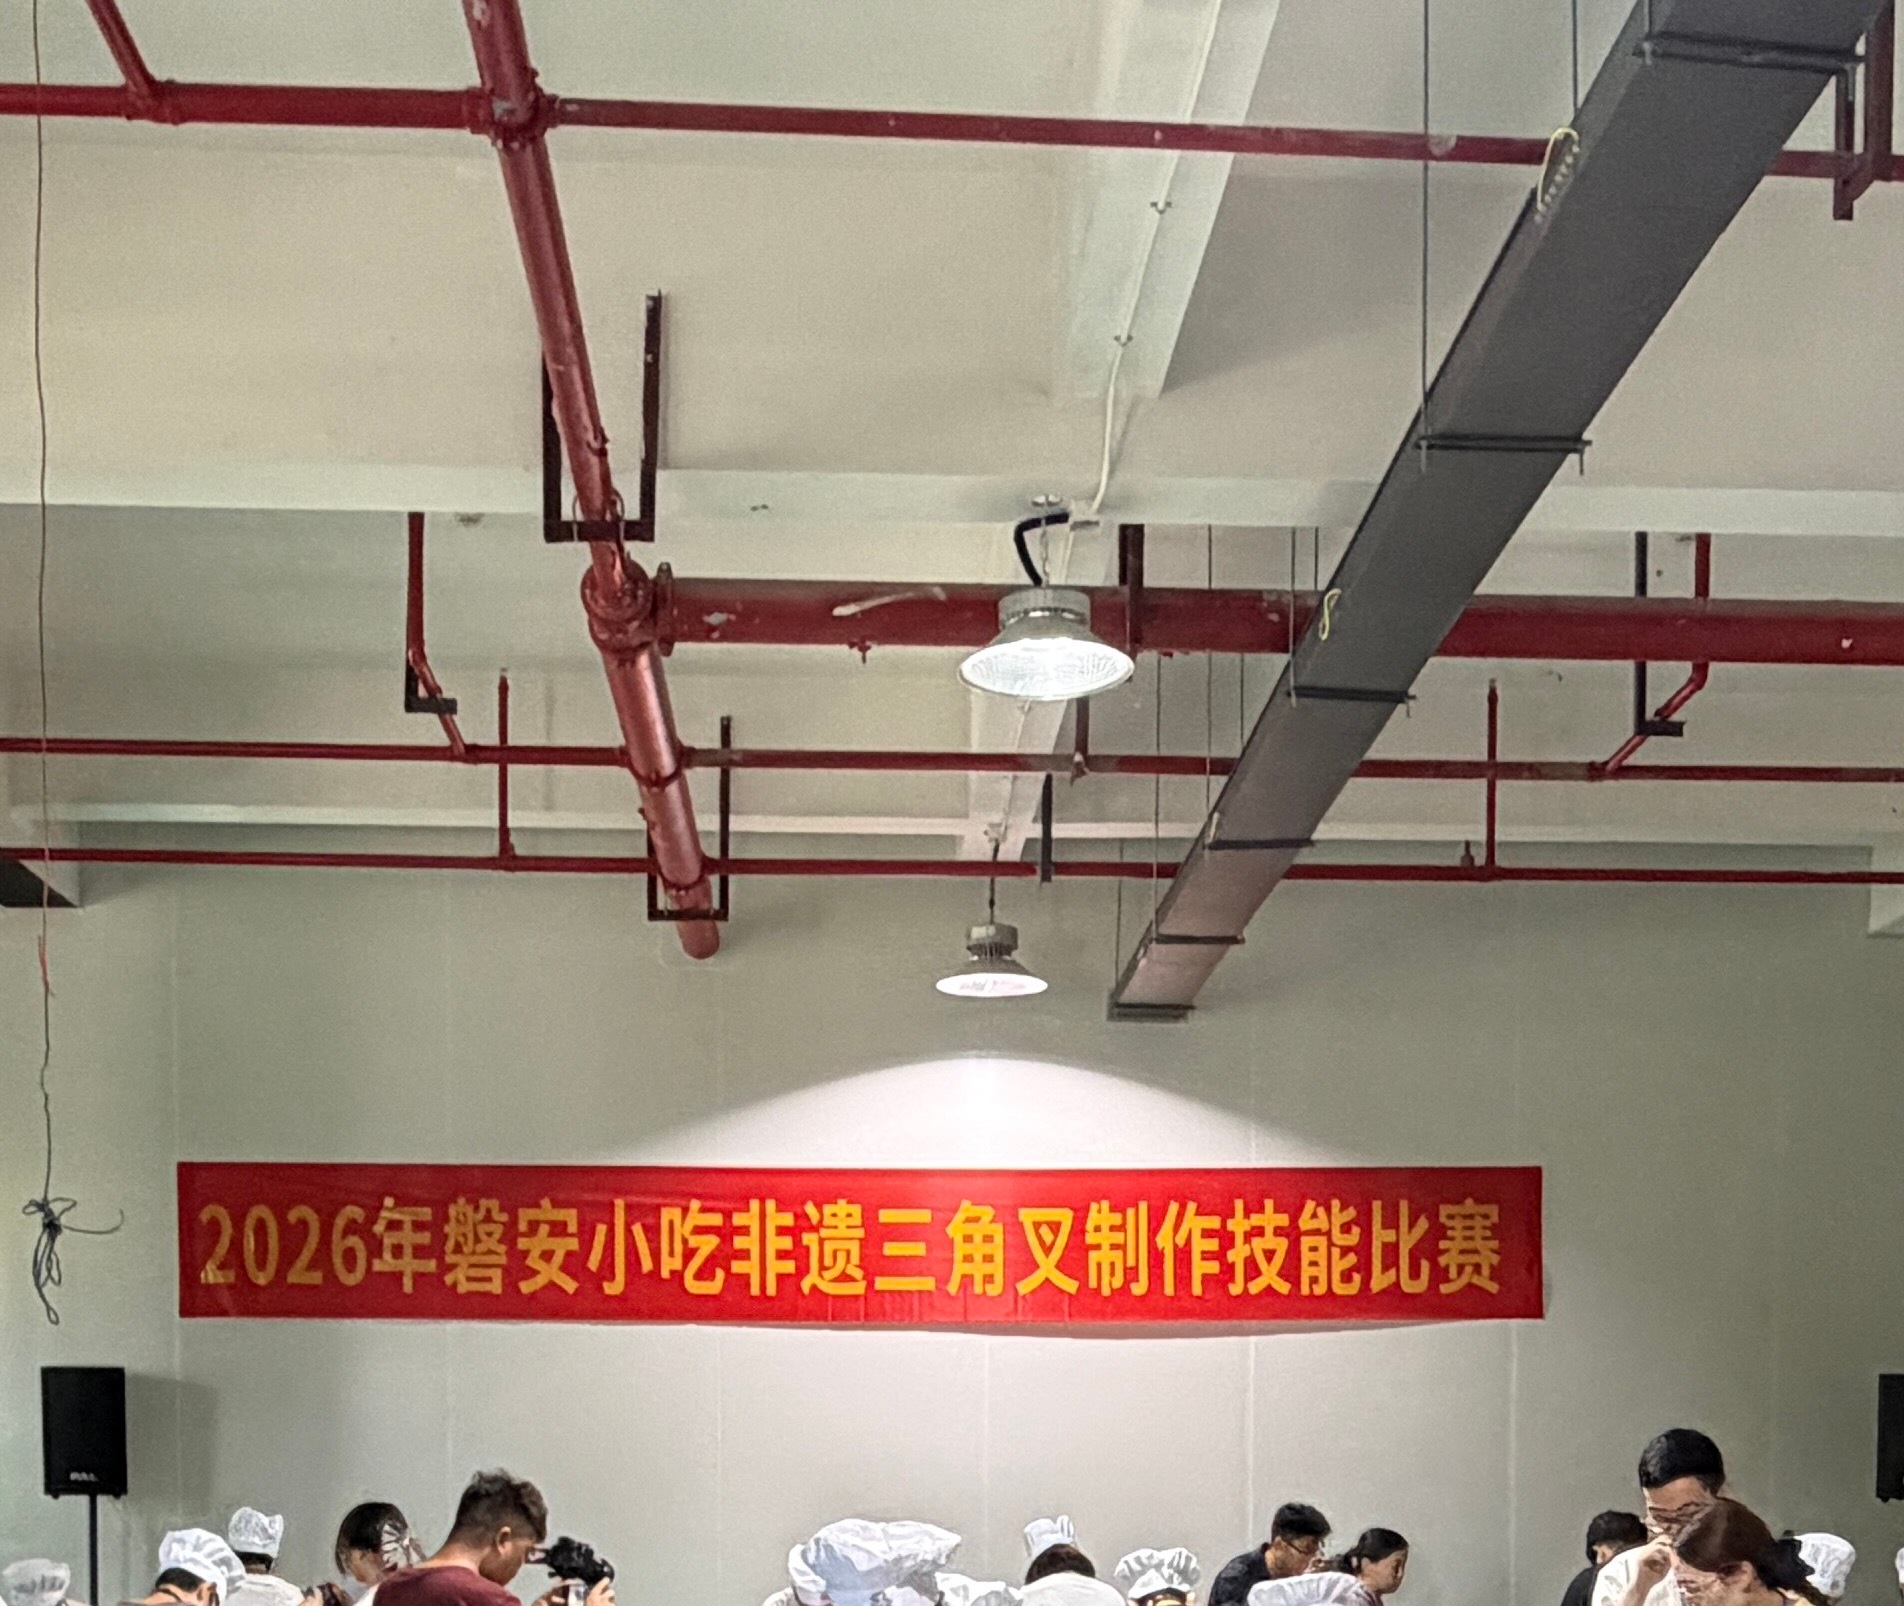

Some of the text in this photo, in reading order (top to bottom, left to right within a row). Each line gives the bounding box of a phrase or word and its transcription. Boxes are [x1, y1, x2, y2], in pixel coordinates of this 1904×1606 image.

[200, 1196, 1501, 1298] 2026年磐安小吃非遗三角叉制作技能比赛
